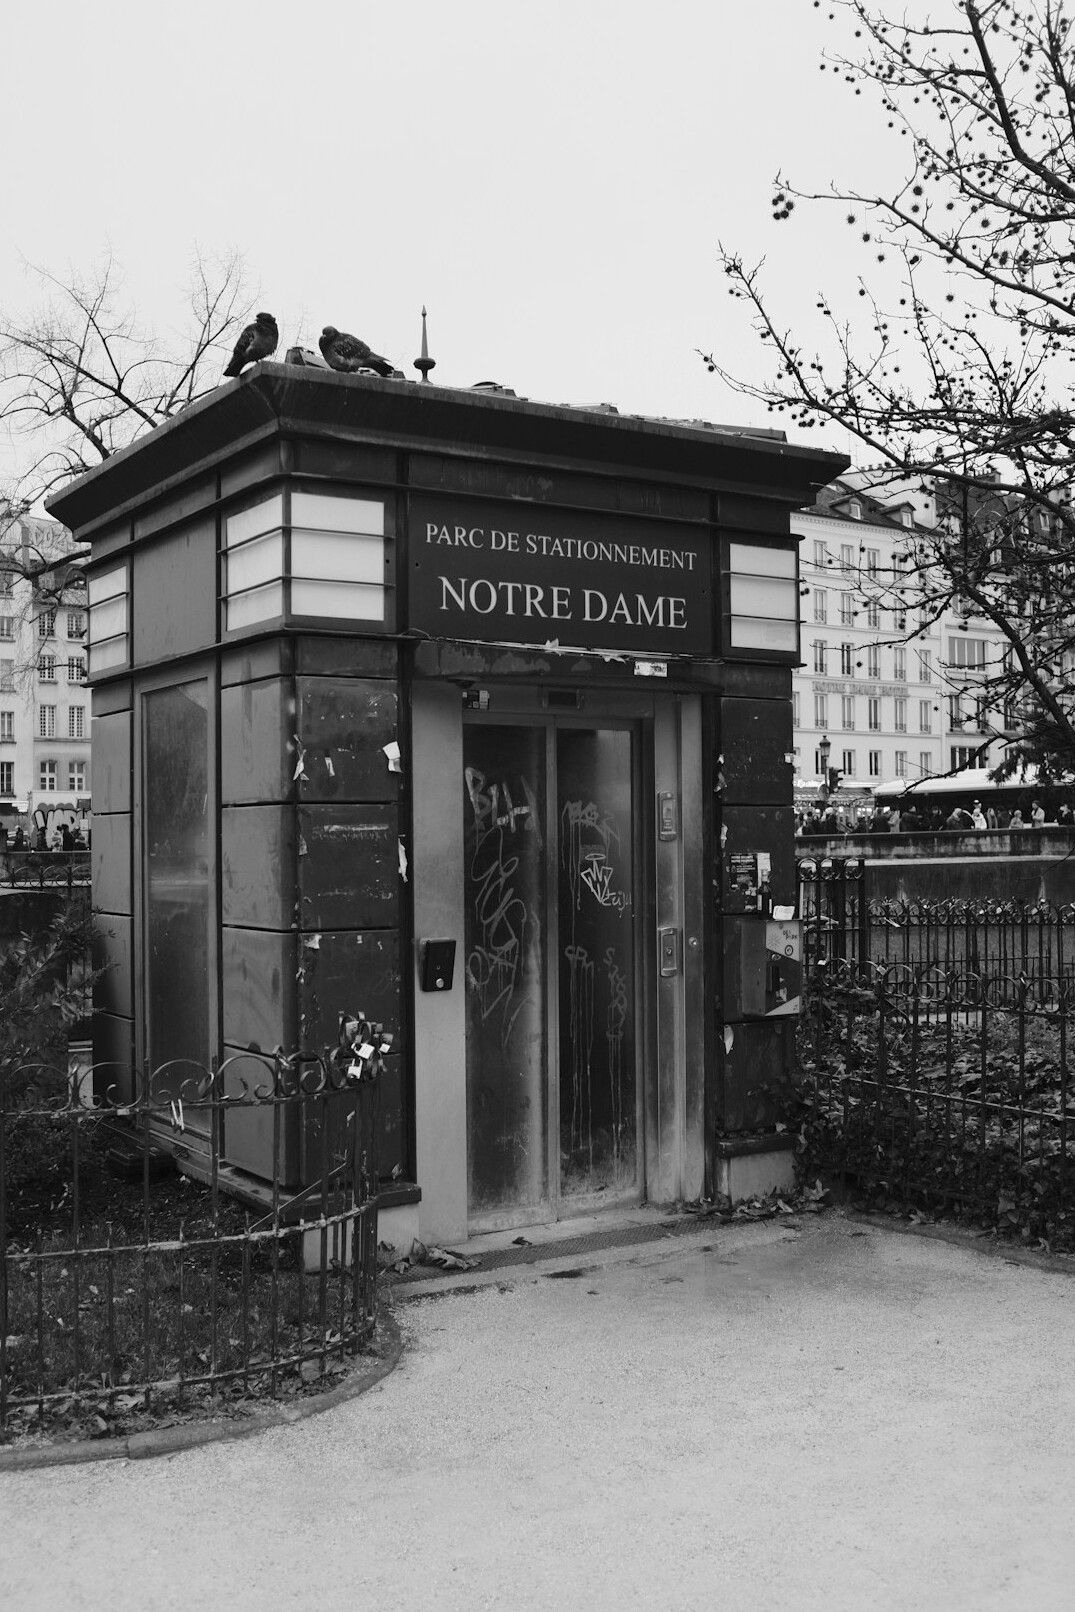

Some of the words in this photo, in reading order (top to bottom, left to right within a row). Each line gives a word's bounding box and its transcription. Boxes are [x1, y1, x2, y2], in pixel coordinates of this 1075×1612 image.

[425, 523, 484, 549] PARC
[490, 530, 520, 553] DE
[525, 534, 698, 571] STATIONNEMENT
[437, 576, 573, 620] NOTRE
[581, 588, 689, 630] DAME
